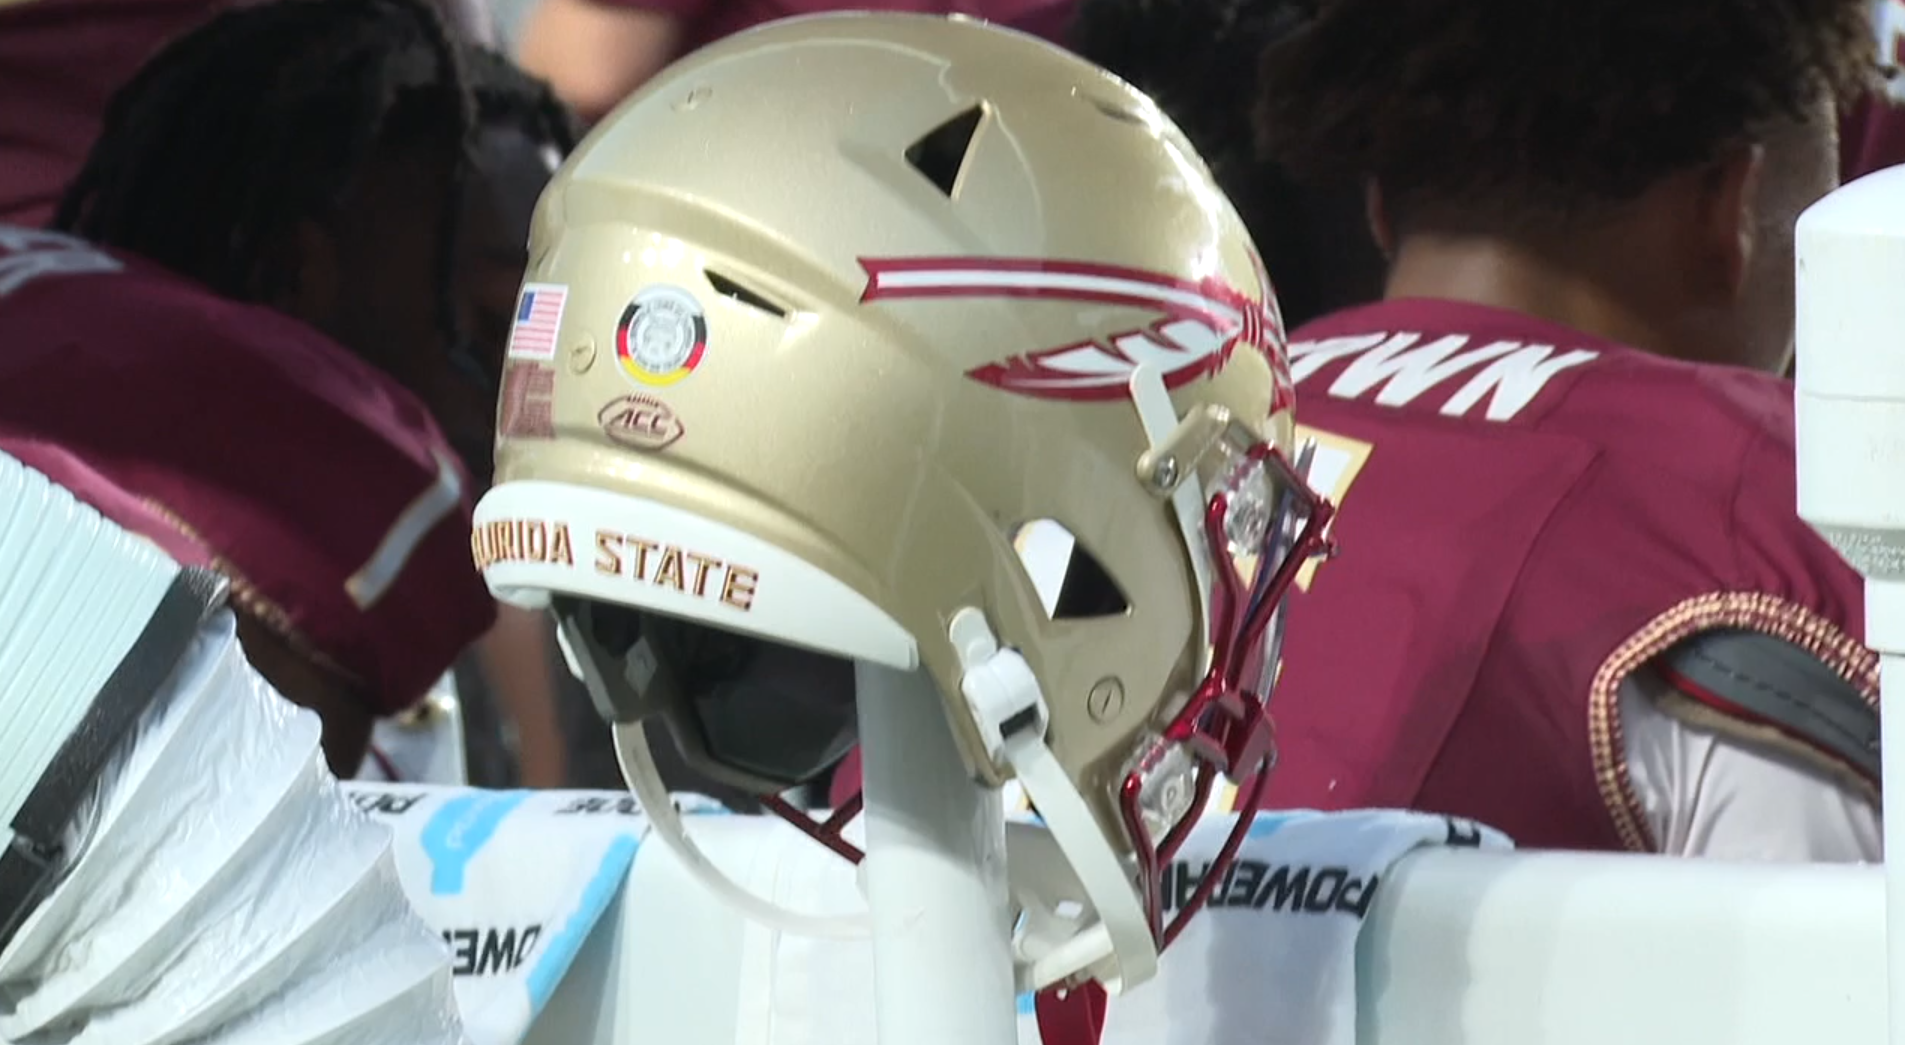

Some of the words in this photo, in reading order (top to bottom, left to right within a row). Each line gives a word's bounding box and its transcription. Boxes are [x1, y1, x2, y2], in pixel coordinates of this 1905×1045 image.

[608, 409, 668, 435] ACC
[595, 529, 759, 611] STATE
[443, 924, 543, 977] OWE
